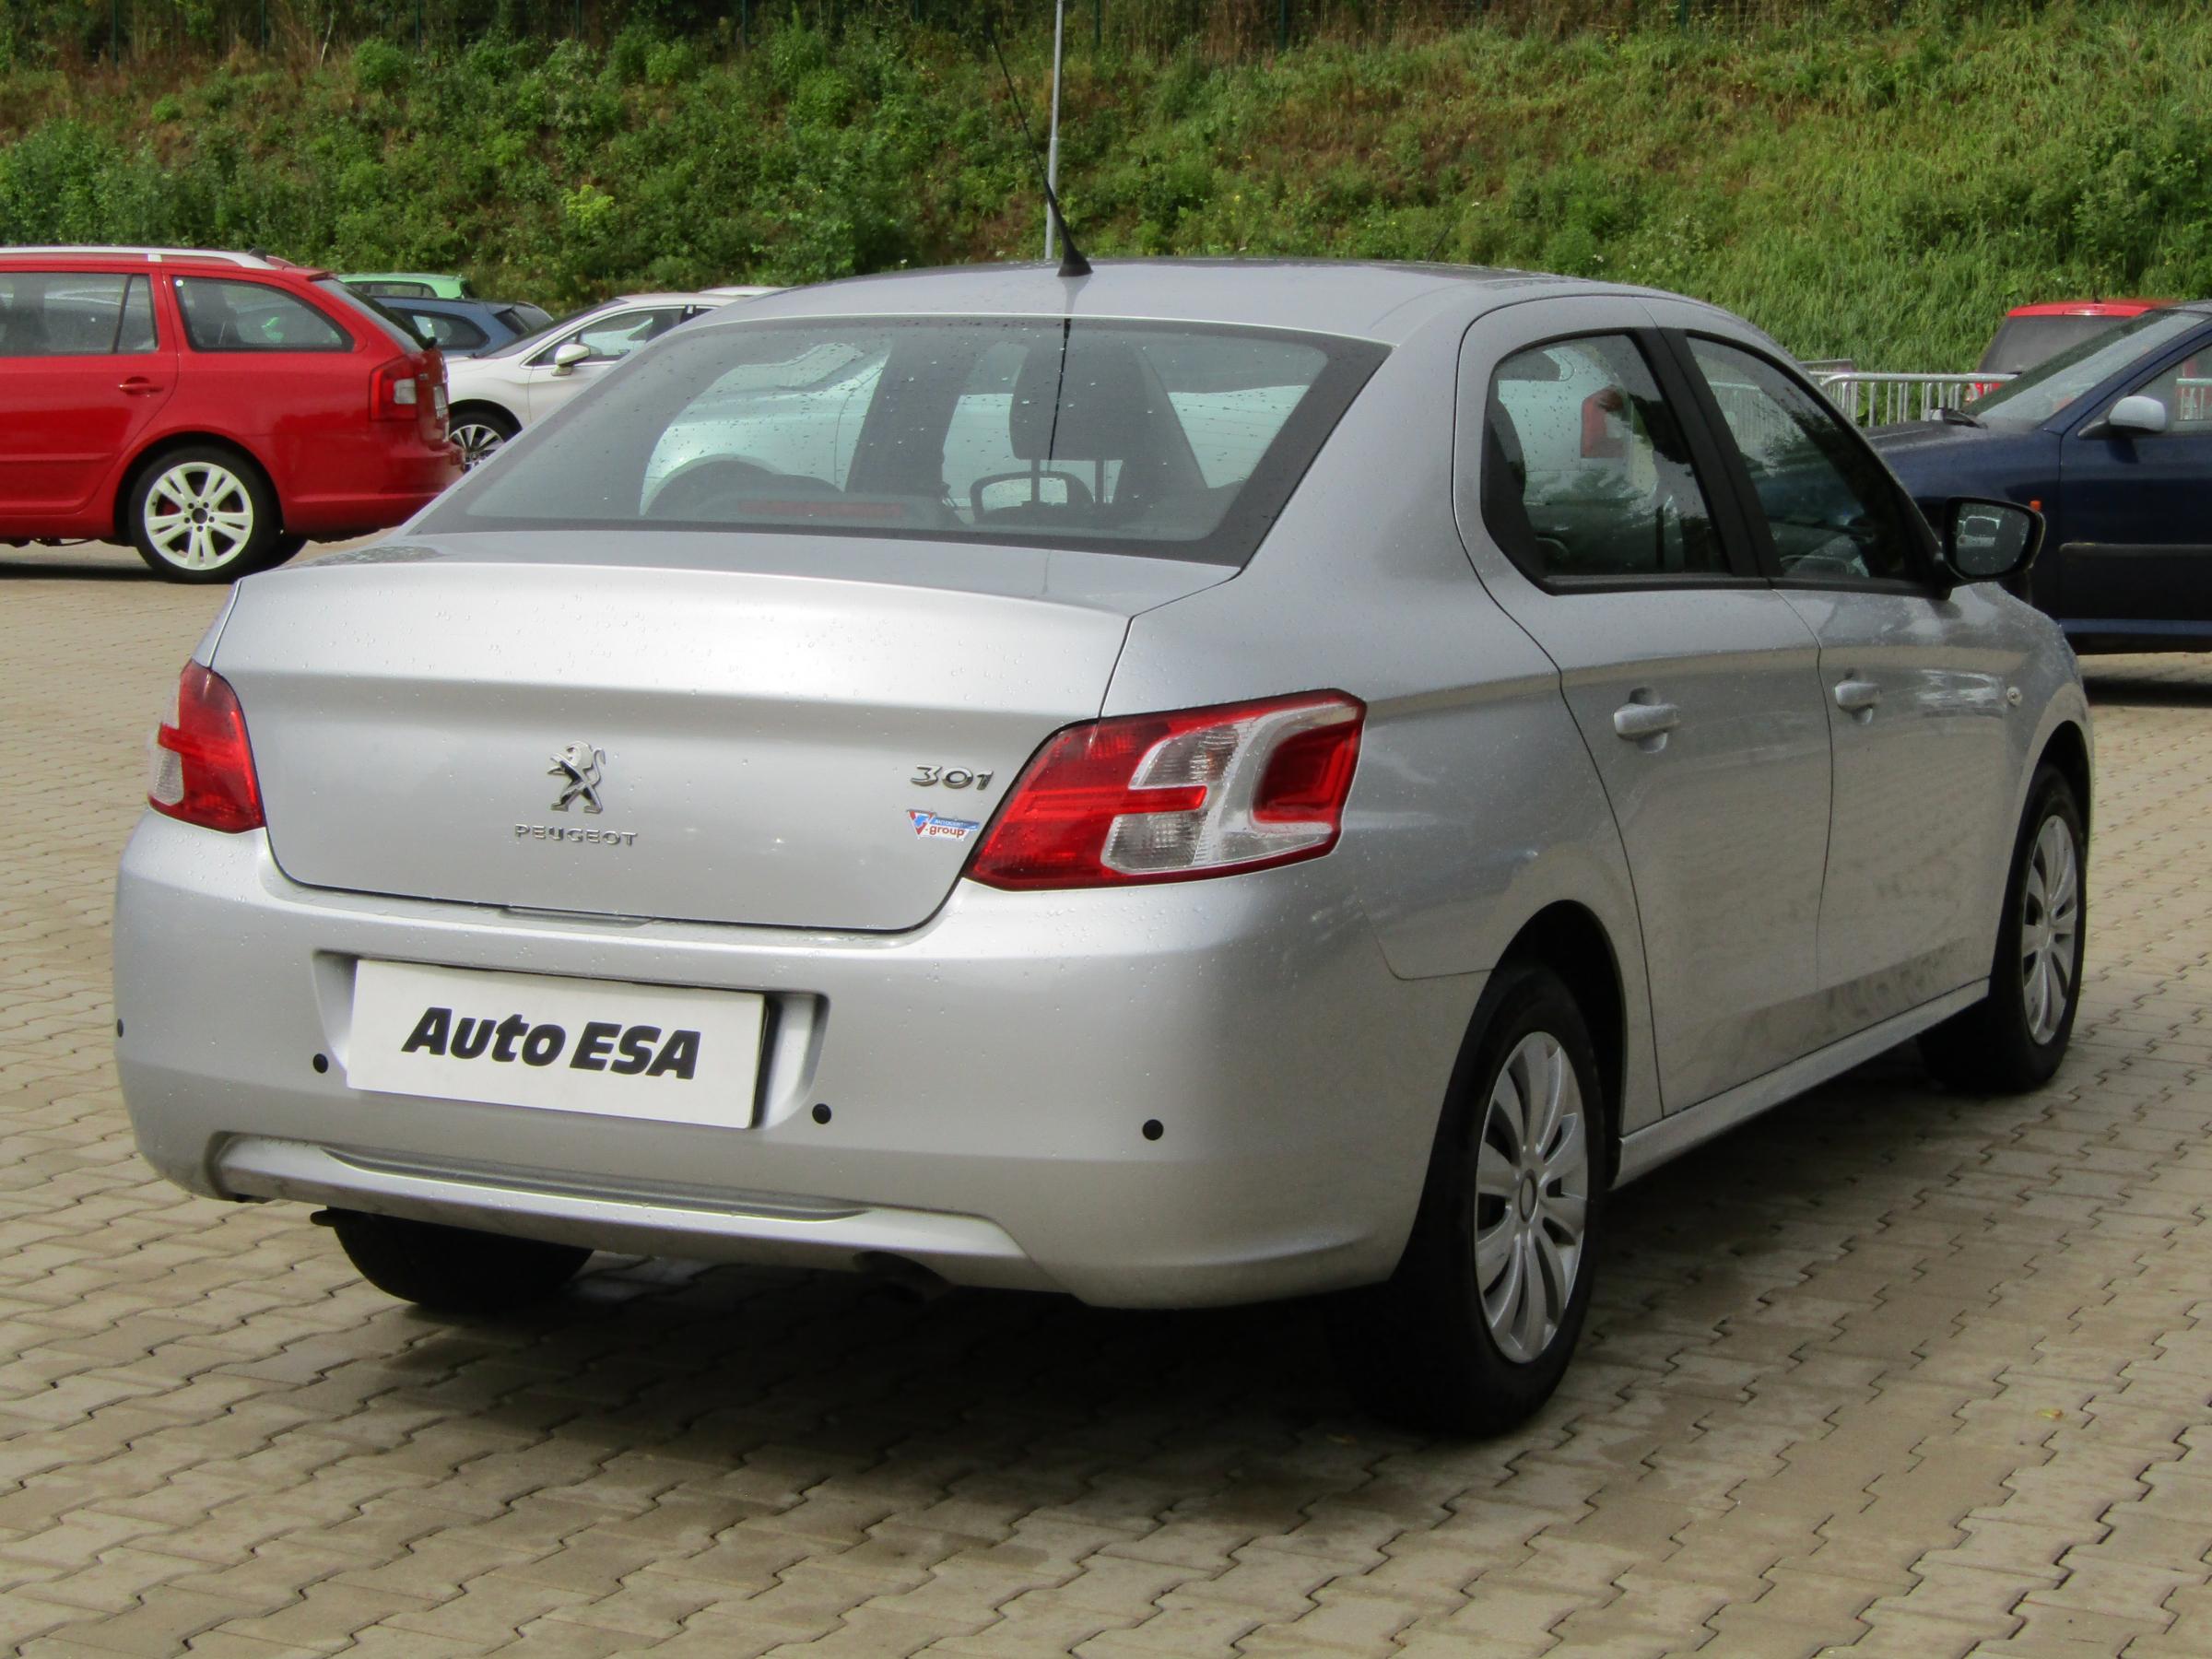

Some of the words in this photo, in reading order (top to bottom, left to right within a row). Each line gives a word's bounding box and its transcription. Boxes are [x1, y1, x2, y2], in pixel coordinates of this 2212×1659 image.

[911, 764, 994, 791] 301
[515, 823, 638, 847] PEUGEOT
[929, 826, 965, 838] group
[401, 1006, 566, 1066] Auto
[569, 1021, 701, 1079] ESA
